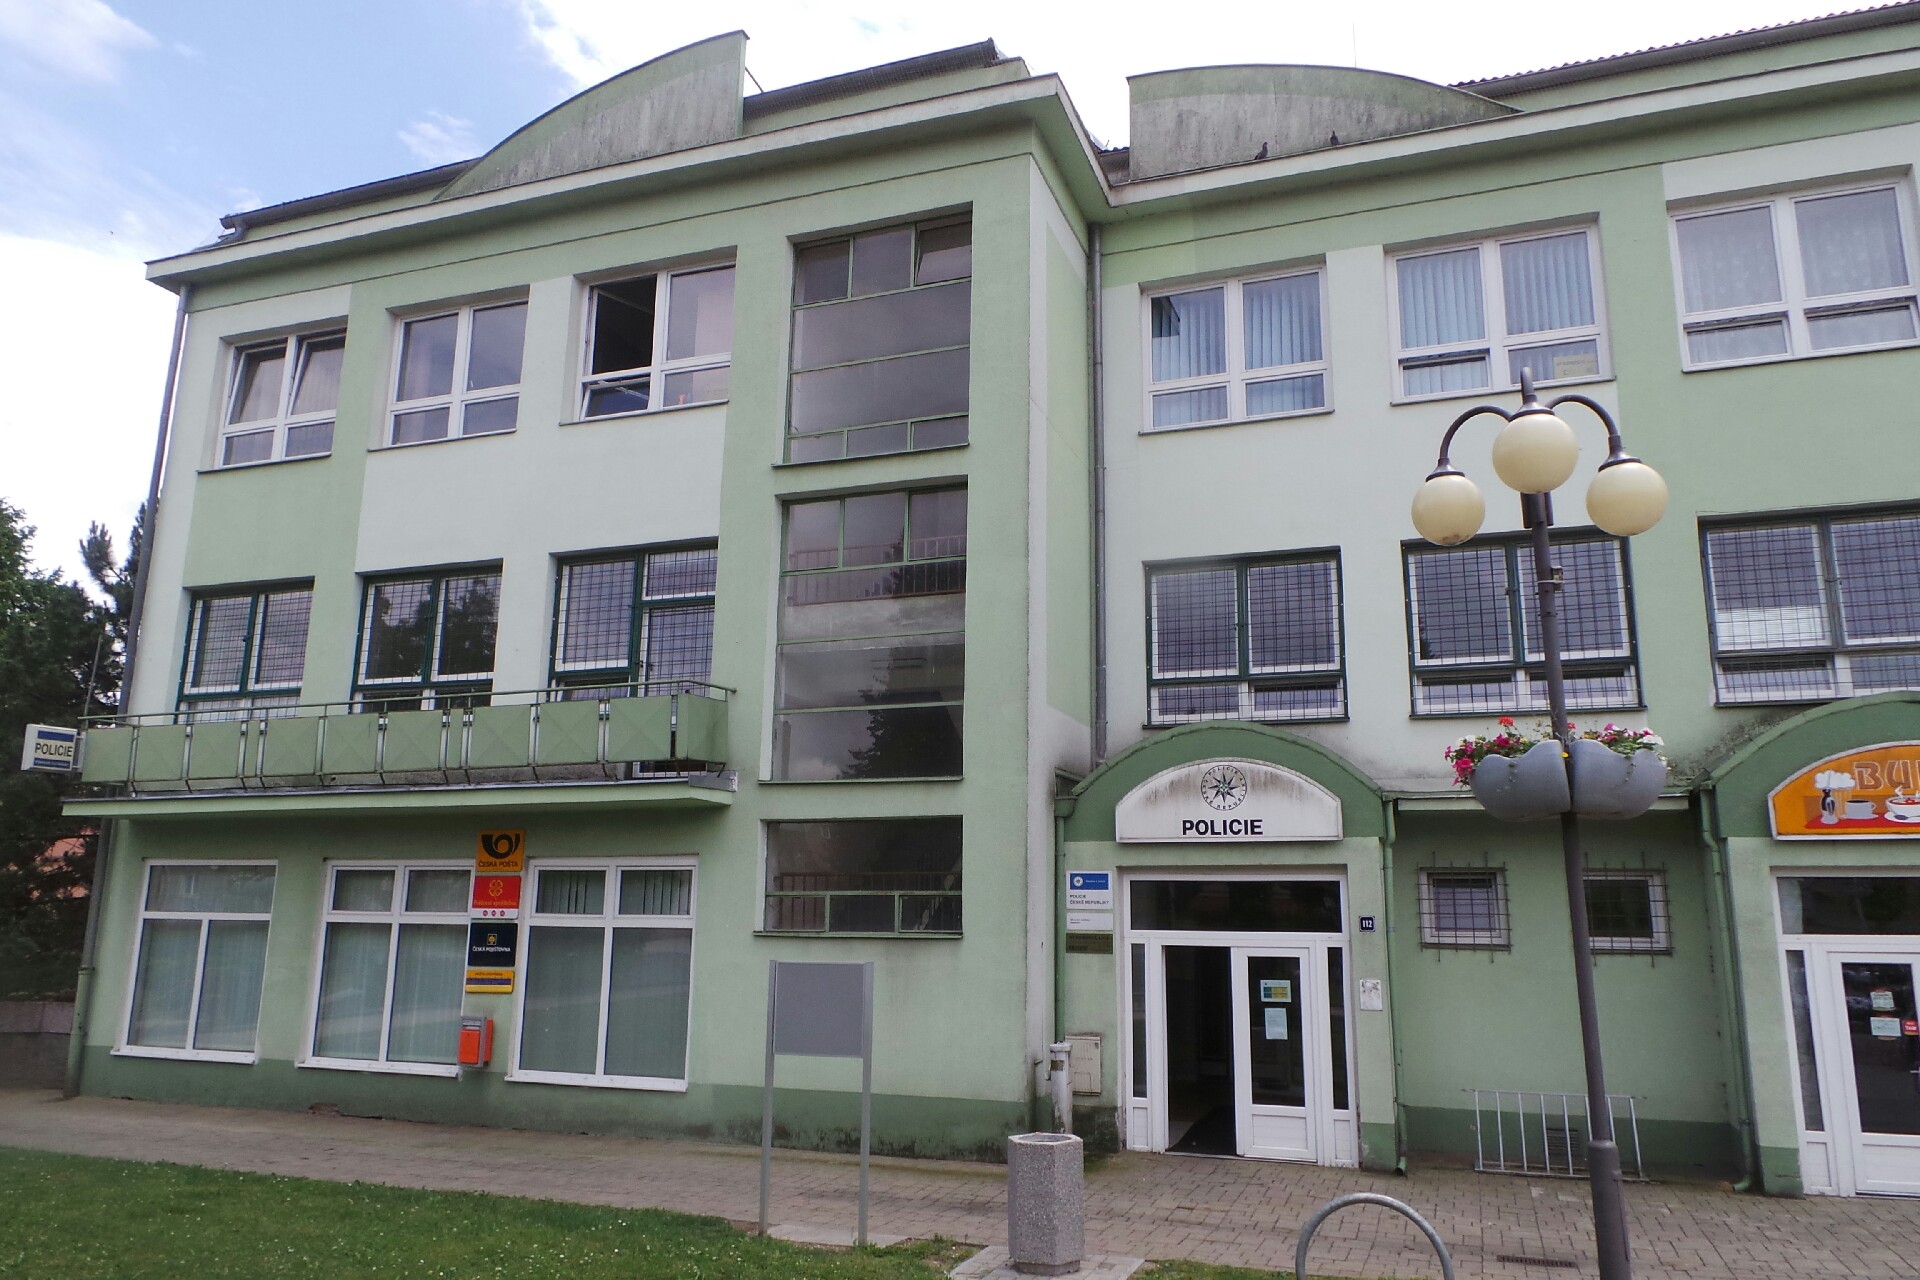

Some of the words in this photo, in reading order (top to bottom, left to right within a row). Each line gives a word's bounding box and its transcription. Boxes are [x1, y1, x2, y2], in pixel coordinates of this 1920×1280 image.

[34, 742, 73, 757] POLICIE
[1854, 759, 1920, 790] BU
[1182, 819, 1264, 836] POLICIE
[498, 860, 519, 868] POŠTA
[1362, 920, 1373, 928] 112
